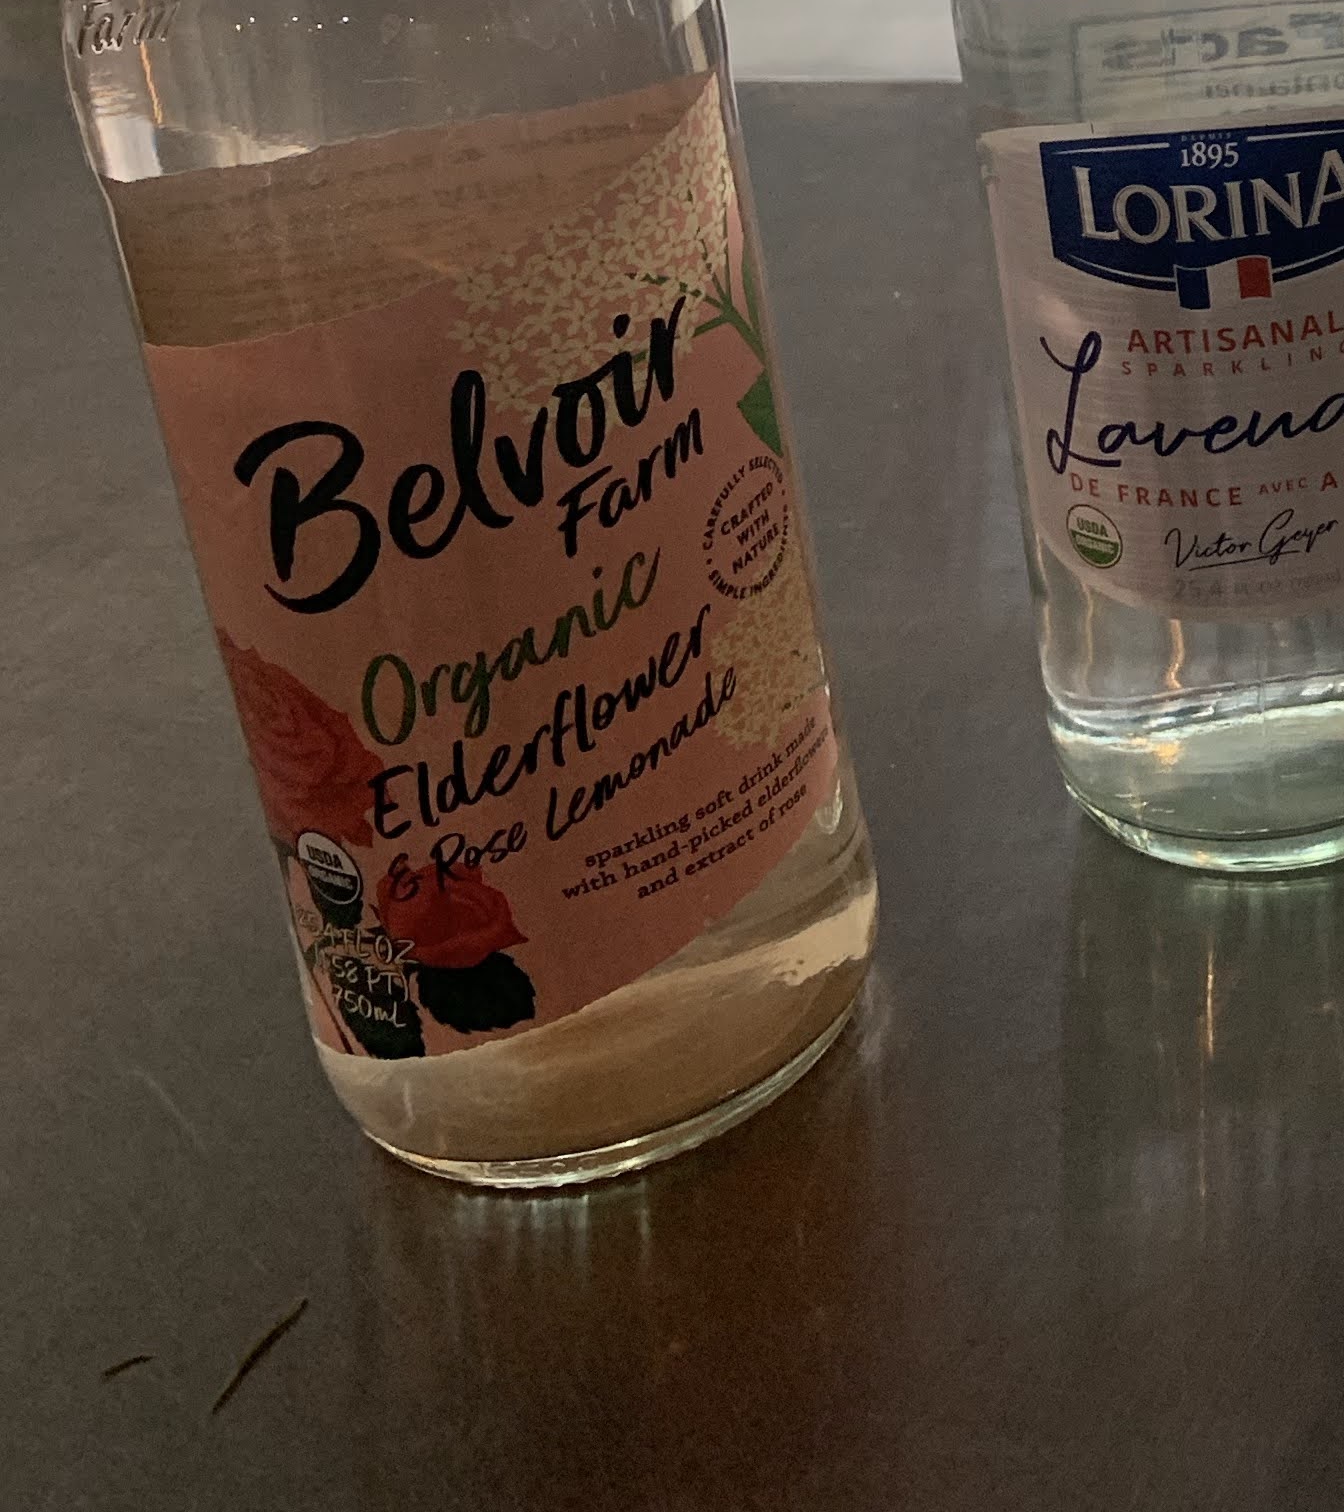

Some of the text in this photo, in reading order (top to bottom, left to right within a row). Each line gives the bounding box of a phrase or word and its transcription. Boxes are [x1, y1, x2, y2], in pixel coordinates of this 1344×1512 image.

[1181, 141, 1240, 170] 1895
[234, 295, 687, 614] Belvoir
[558, 408, 704, 558] Farm
[1068, 471, 1101, 499] DE
[1117, 483, 1243, 509] FRANCE
[1257, 477, 1309, 497] AVEC
[720, 481, 774, 536] CRAFTED
[735, 508, 771, 547] WITH
[1077, 516, 1109, 538] USDA
[731, 522, 780, 575] NATURE
[361, 546, 661, 745] Organic
[369, 604, 713, 841] Elderflower
[430, 813, 528, 894] Rose
[545, 666, 738, 841] Lemonade
[585, 813, 692, 869] sparkling
[695, 787, 735, 821] soft
[738, 751, 784, 796] drink
[305, 844, 344, 870] USDA
[561, 870, 618, 900] with
[623, 798, 755, 880] hand-picked
[637, 783, 808, 899] and extract of rose
[338, 928, 370, 959] FL
[374, 934, 421, 965] OZ
